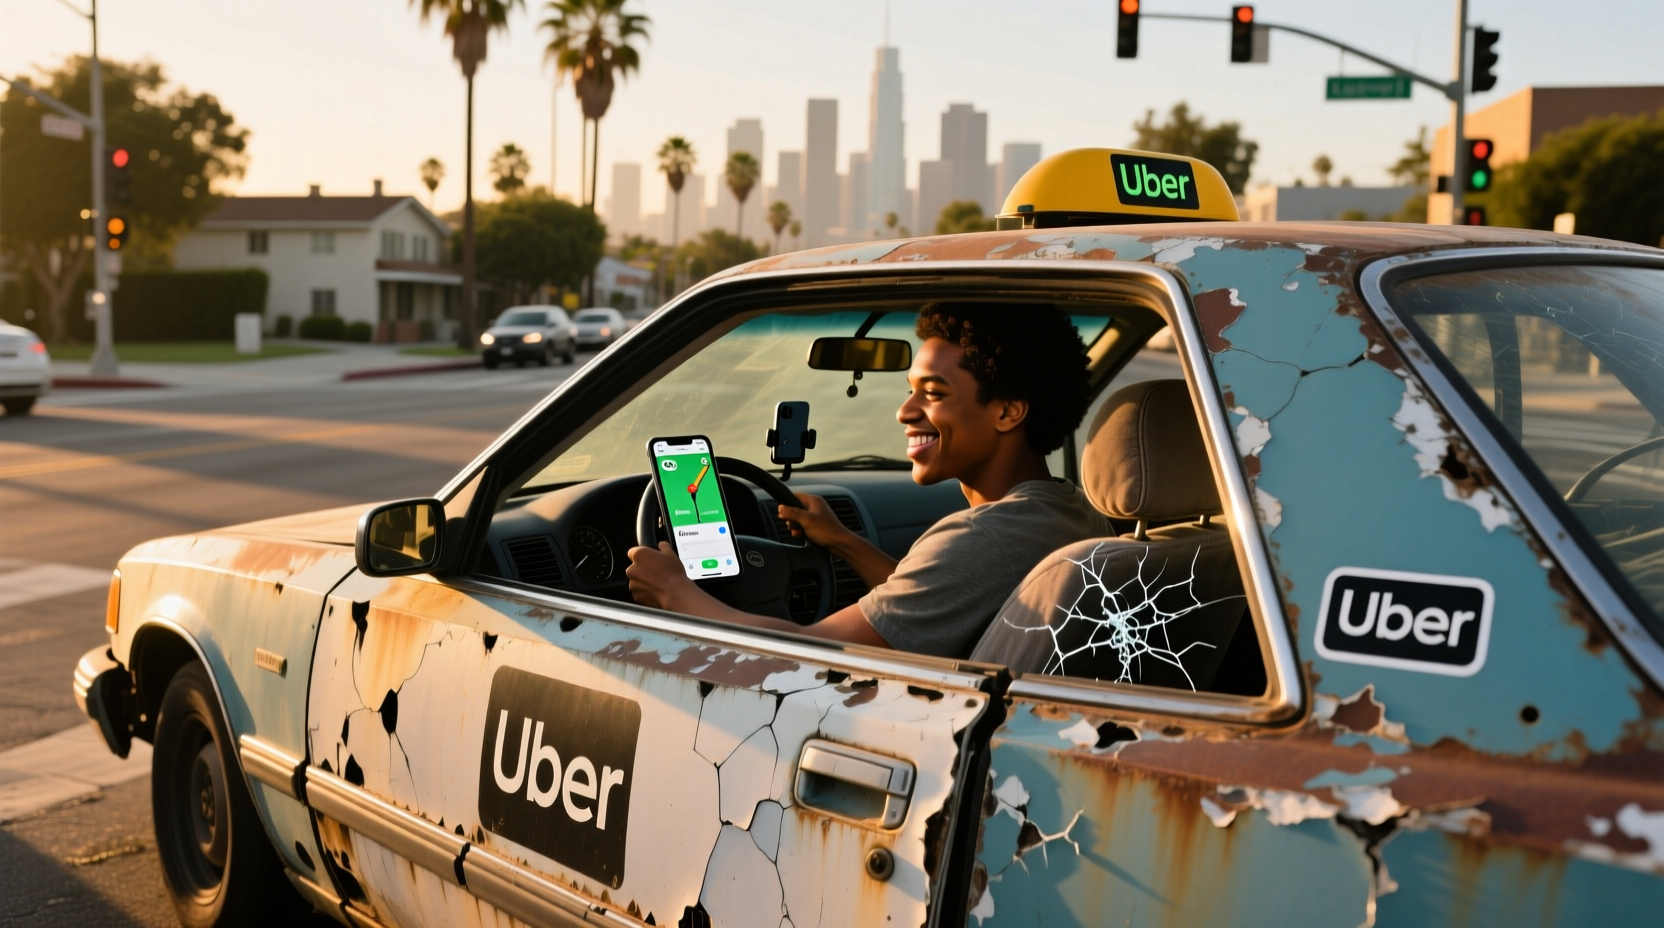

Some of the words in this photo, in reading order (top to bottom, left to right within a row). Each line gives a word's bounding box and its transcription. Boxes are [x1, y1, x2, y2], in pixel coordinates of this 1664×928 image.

[1120, 163, 1189, 199] Uber
[1338, 588, 1475, 647] Uber
[493, 709, 624, 830] Uber
